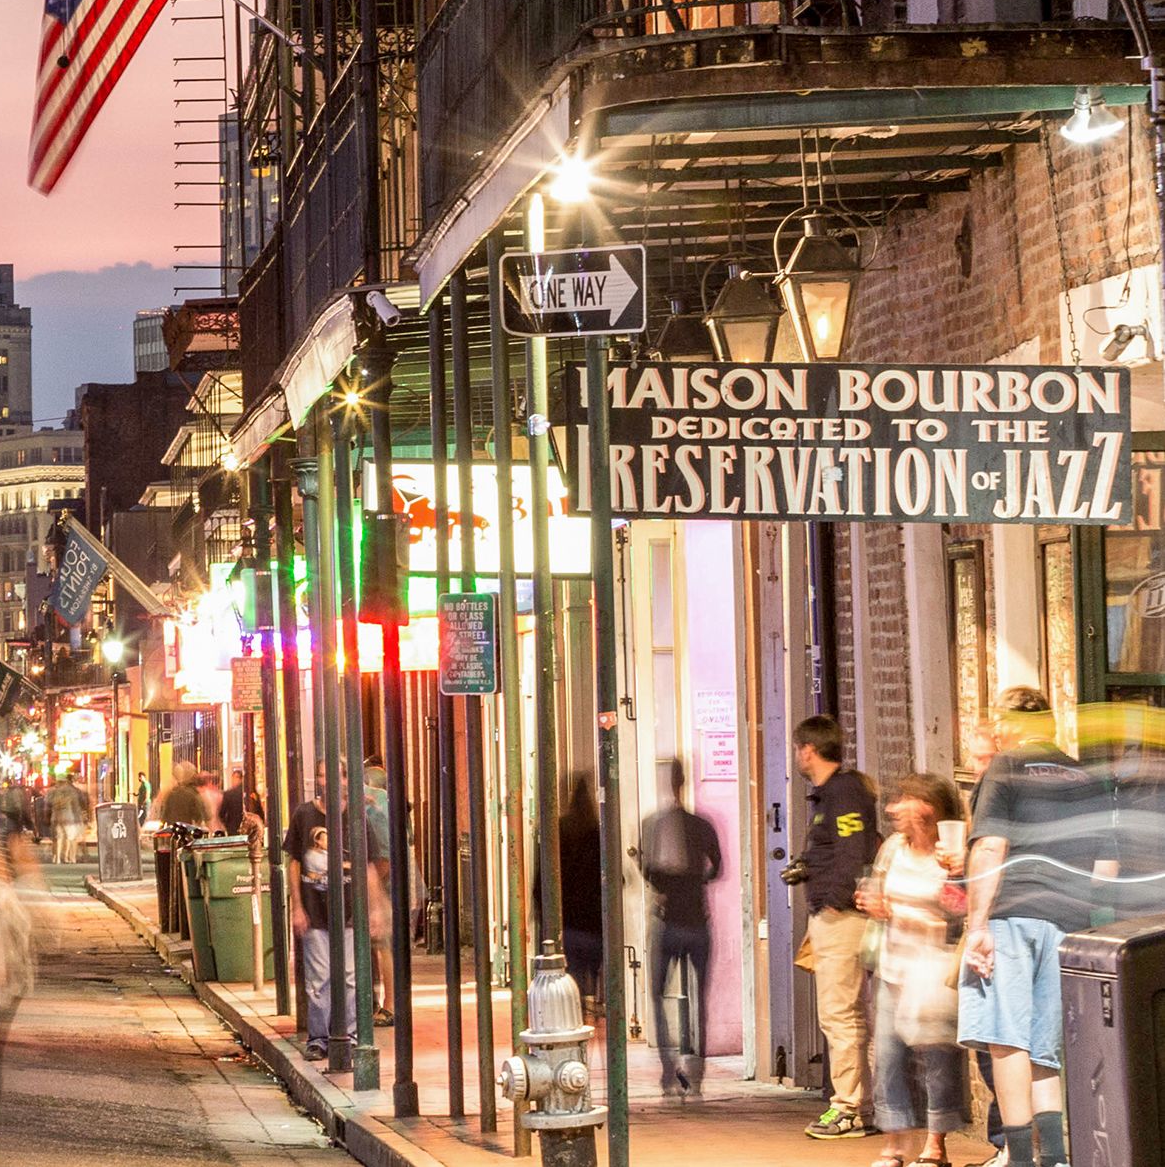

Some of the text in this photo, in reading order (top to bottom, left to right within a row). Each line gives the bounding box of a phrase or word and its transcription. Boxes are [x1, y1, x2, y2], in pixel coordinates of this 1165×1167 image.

[530, 276, 607, 309] ONE WAY
[576, 367, 1121, 414] MAISON BOURBON
[651, 416, 1051, 443] DEDICATED TO THE
[971, 470, 1002, 491] OF
[992, 431, 1124, 520] JAZZ
[456, 602, 488, 611] BOTTLES
[450, 621, 483, 630] ALLOWED
[459, 612, 484, 621] GLASS
[459, 631, 486, 640] STREET
